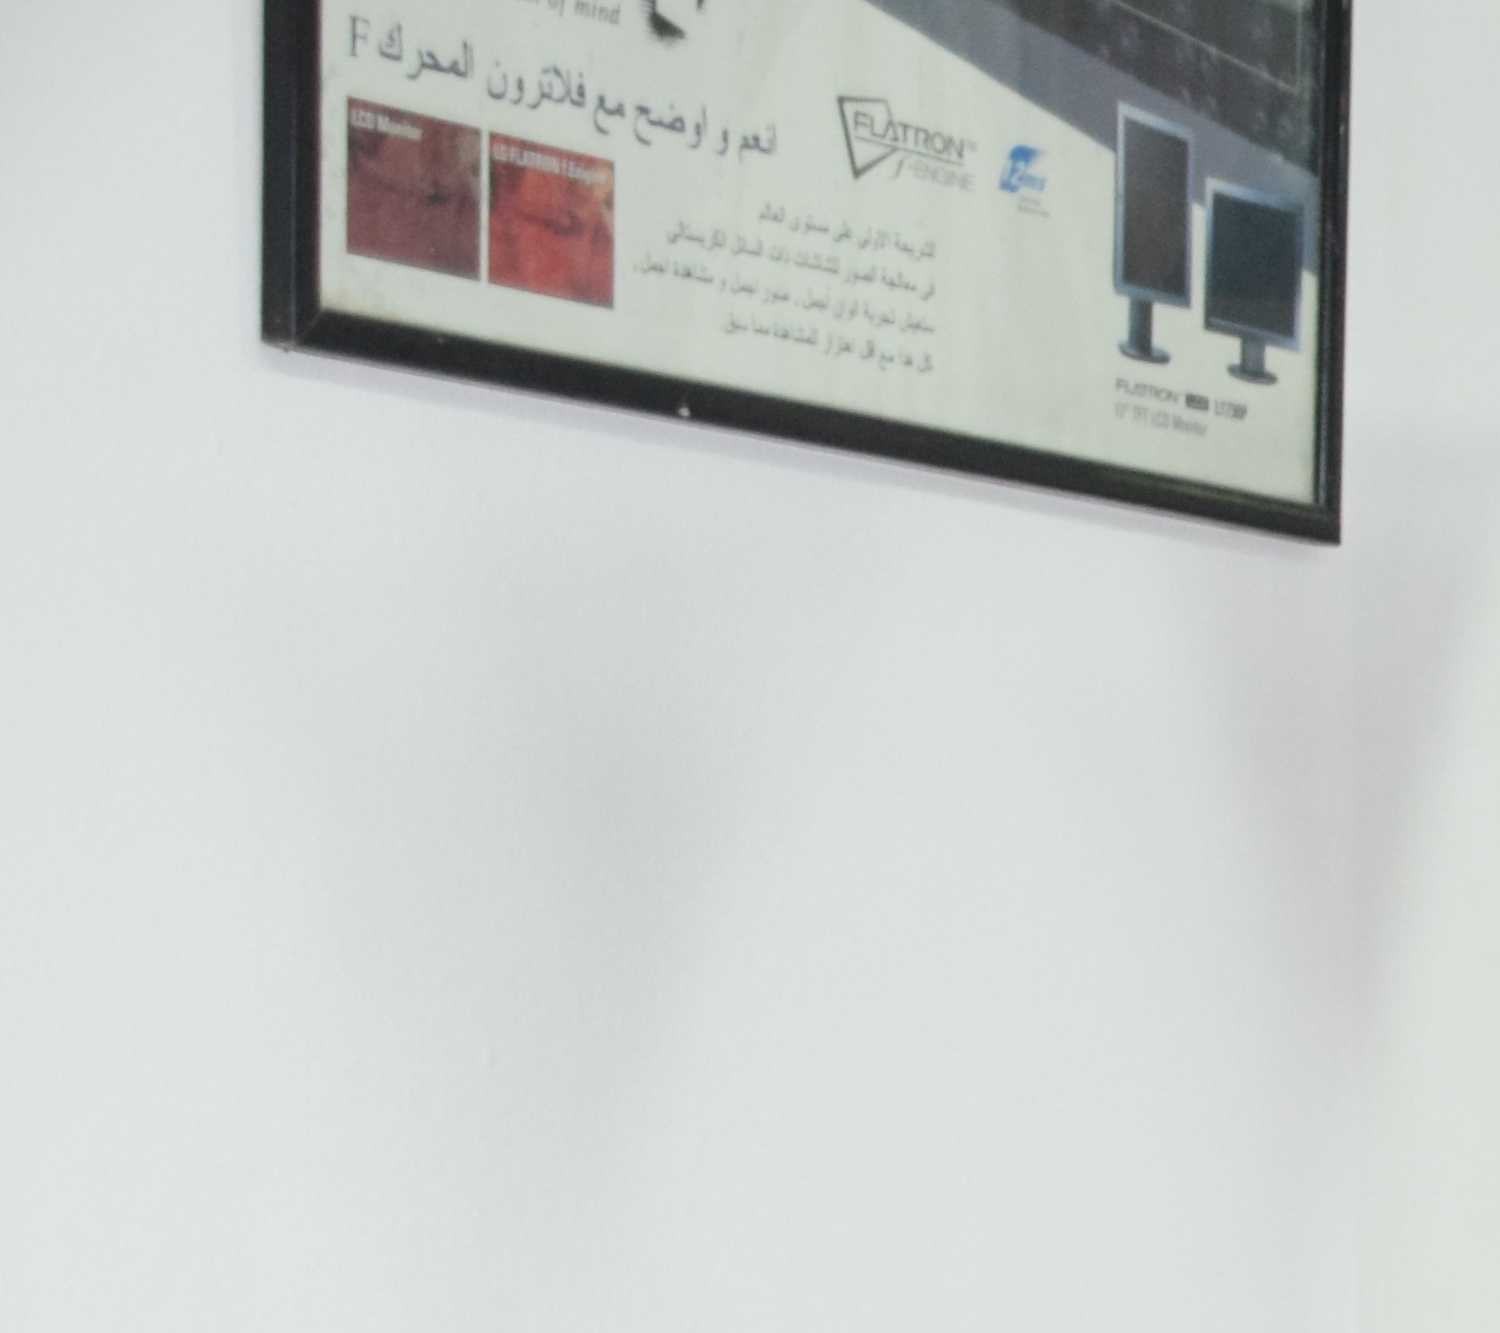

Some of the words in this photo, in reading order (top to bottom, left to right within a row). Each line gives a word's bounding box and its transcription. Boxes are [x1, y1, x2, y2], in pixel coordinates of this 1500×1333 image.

[348, 13, 371, 58] F
[377, 22, 475, 80] المحرك
[486, 60, 587, 110] فلاترون
[592, 93, 626, 135] مع
[853, 110, 965, 159] FLATRON
